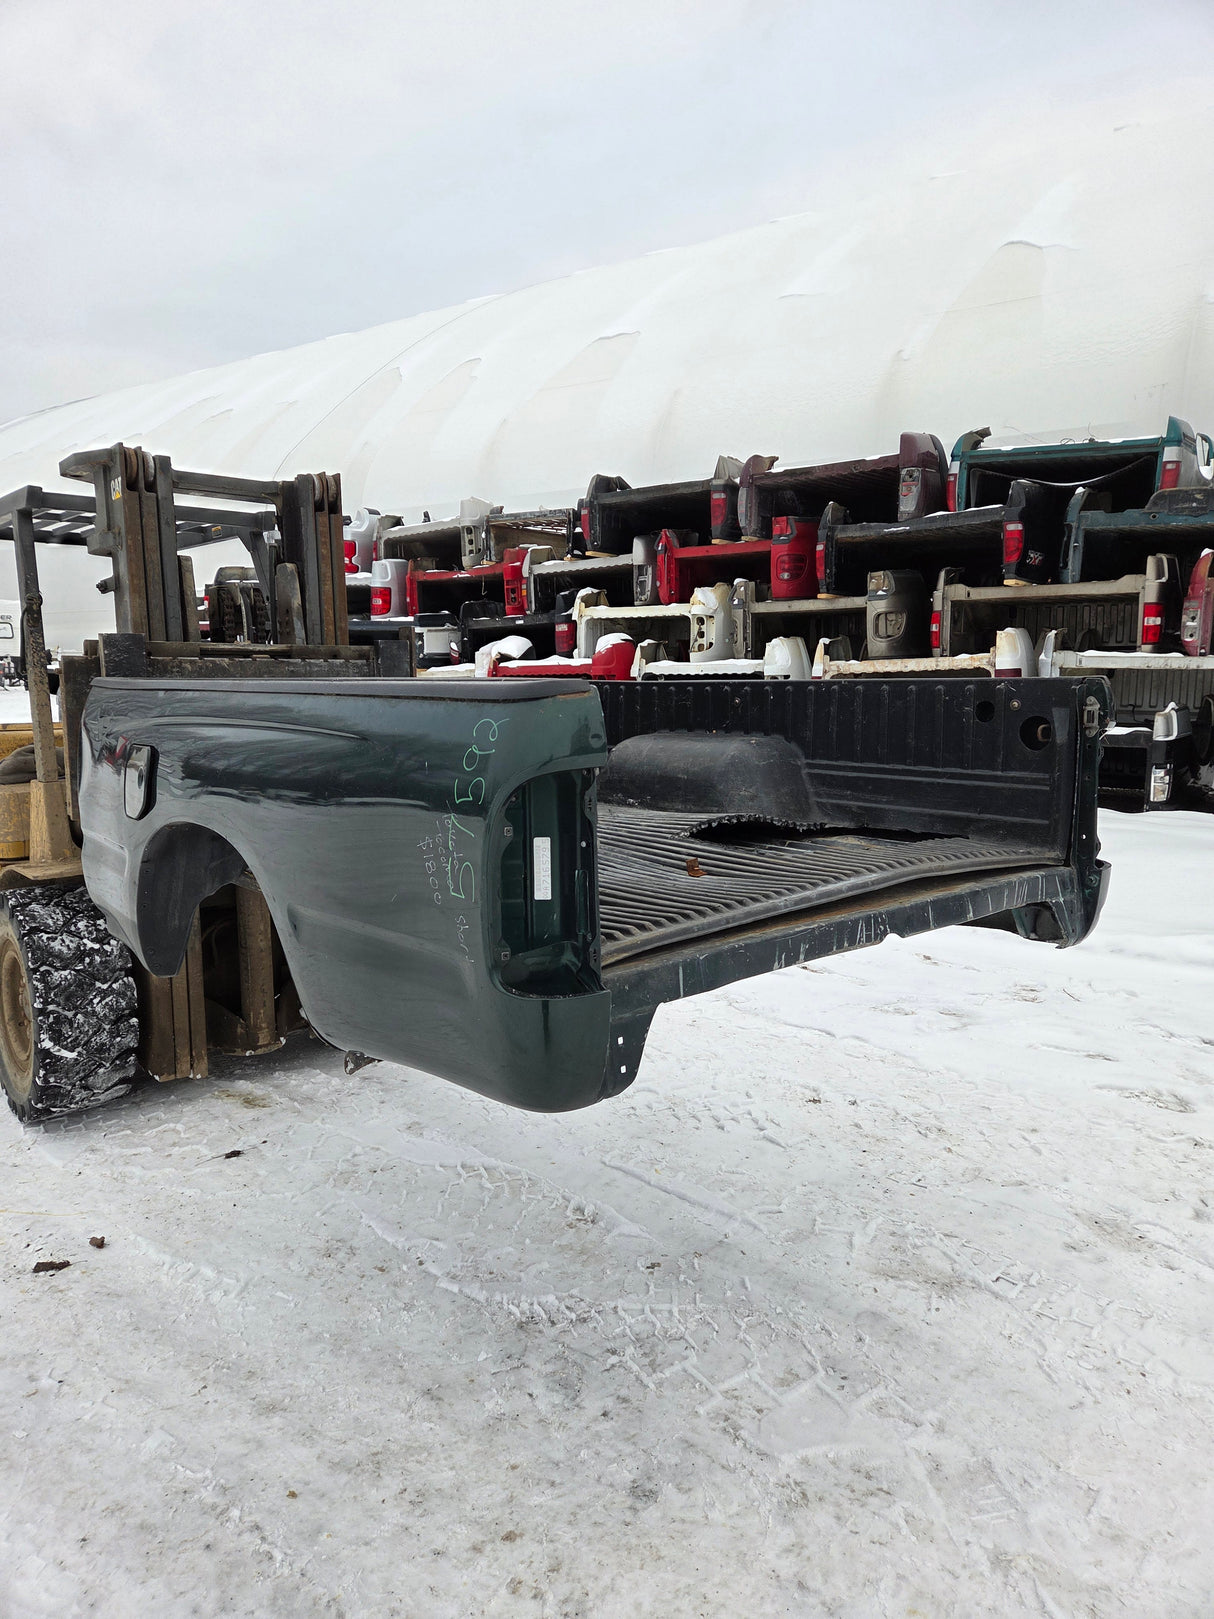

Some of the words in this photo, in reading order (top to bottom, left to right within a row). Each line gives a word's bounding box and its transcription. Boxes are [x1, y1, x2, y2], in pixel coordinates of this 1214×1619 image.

[110, 476, 122, 501] CAT
[449, 718, 510, 902] 57592
[416, 836, 442, 905] $1800
